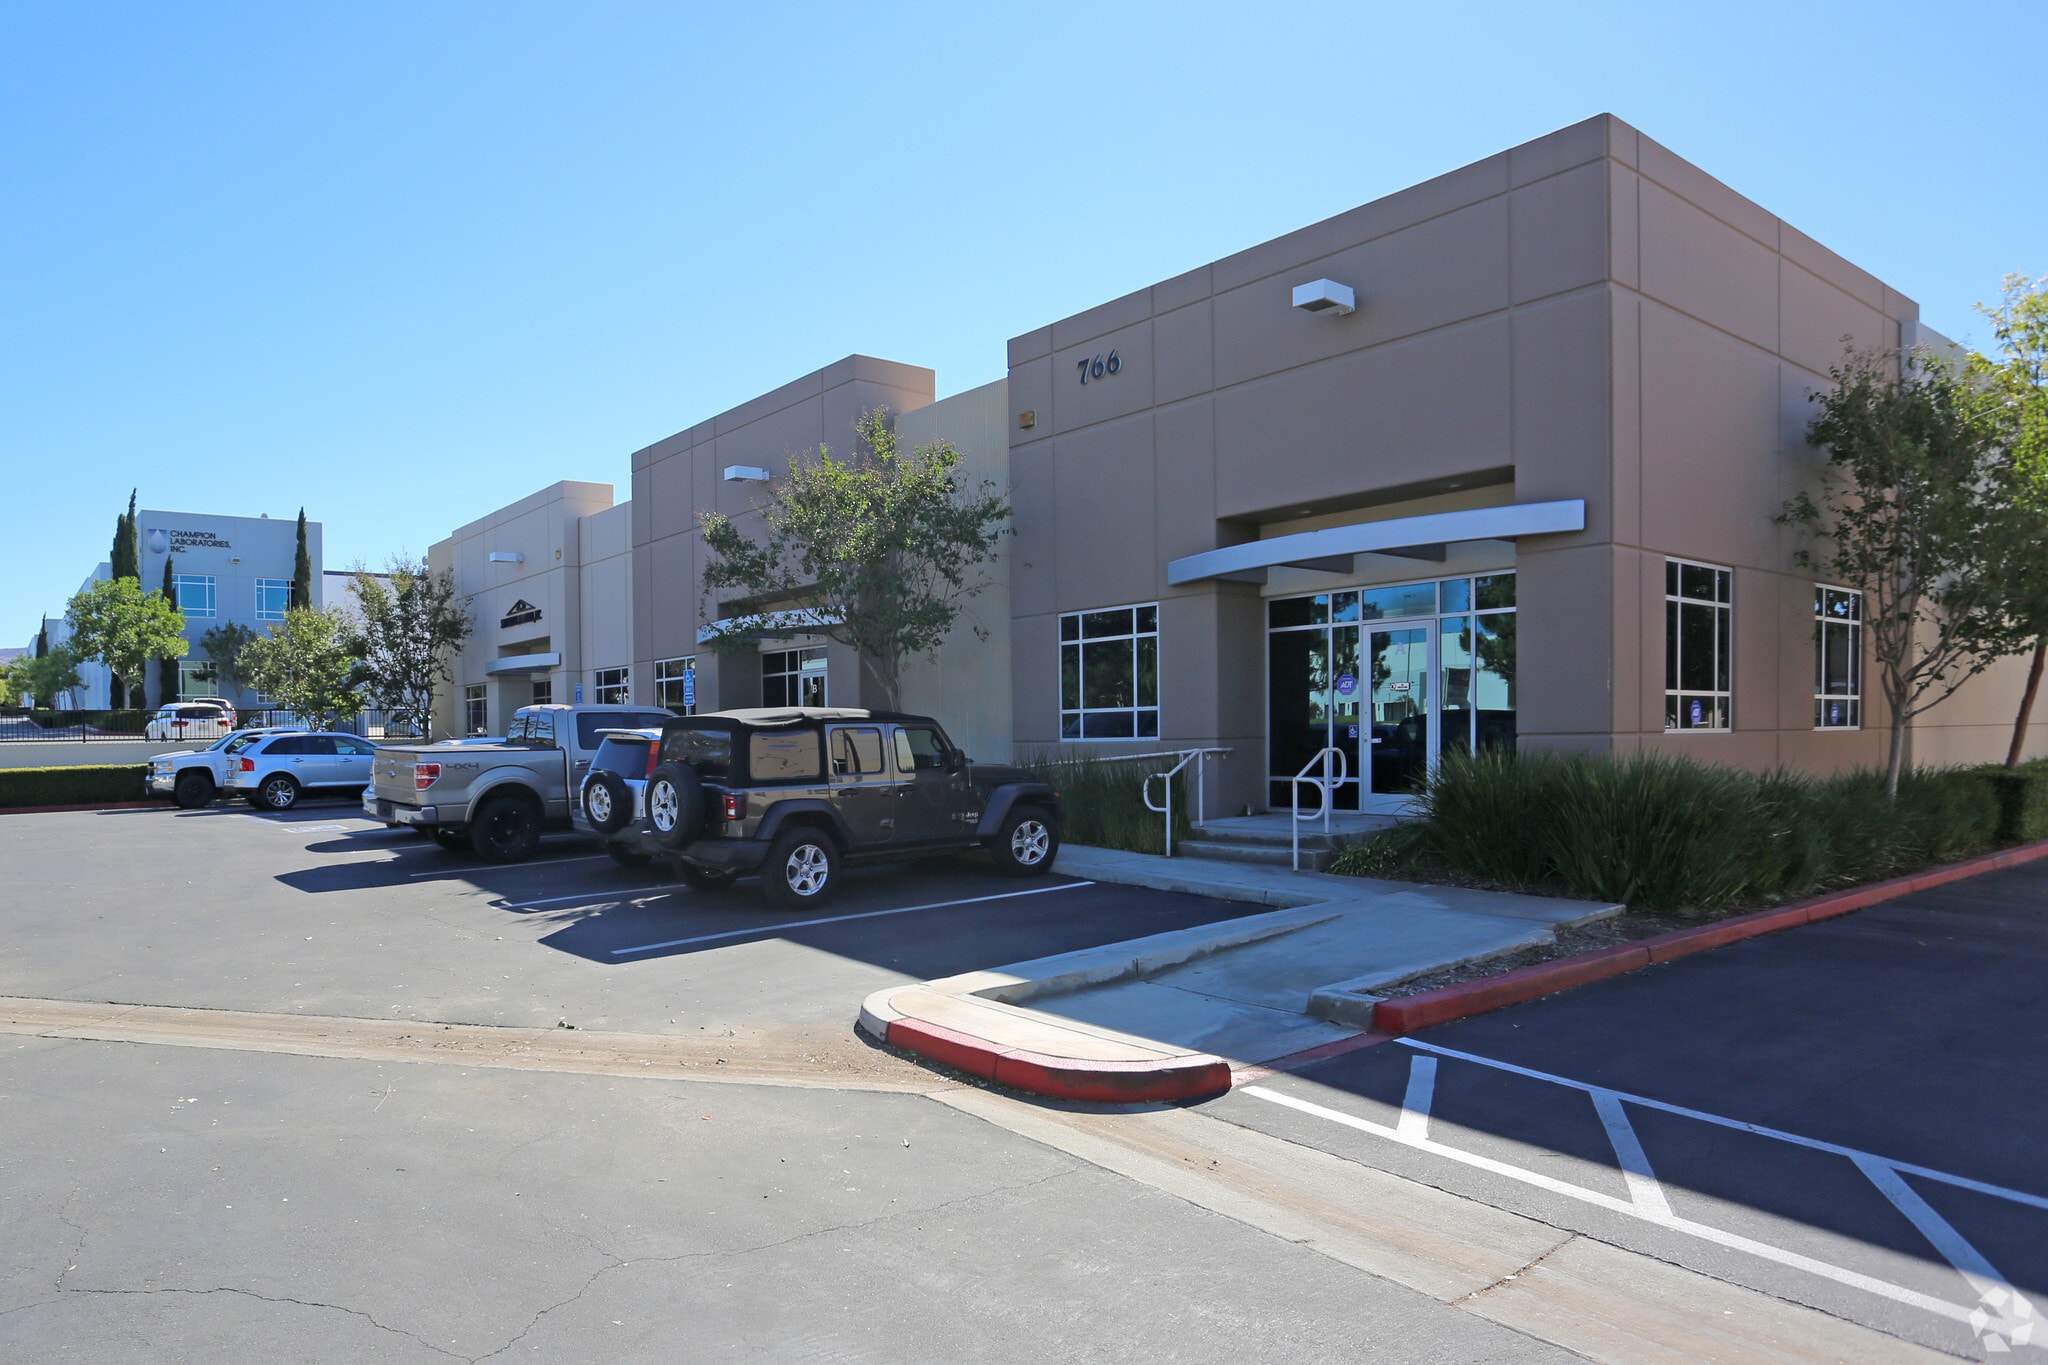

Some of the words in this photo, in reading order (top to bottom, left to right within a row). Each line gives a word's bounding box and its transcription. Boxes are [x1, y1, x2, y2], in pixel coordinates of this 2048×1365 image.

[1077, 349, 1122, 385] 766
[170, 529, 216, 540] CHAMPION
[170, 538, 232, 549] LABORATORIES,
[170, 545, 187, 553] INC.
[1395, 641, 1406, 656] A
[812, 684, 818, 694] B
[1340, 680, 1354, 689] ADT
